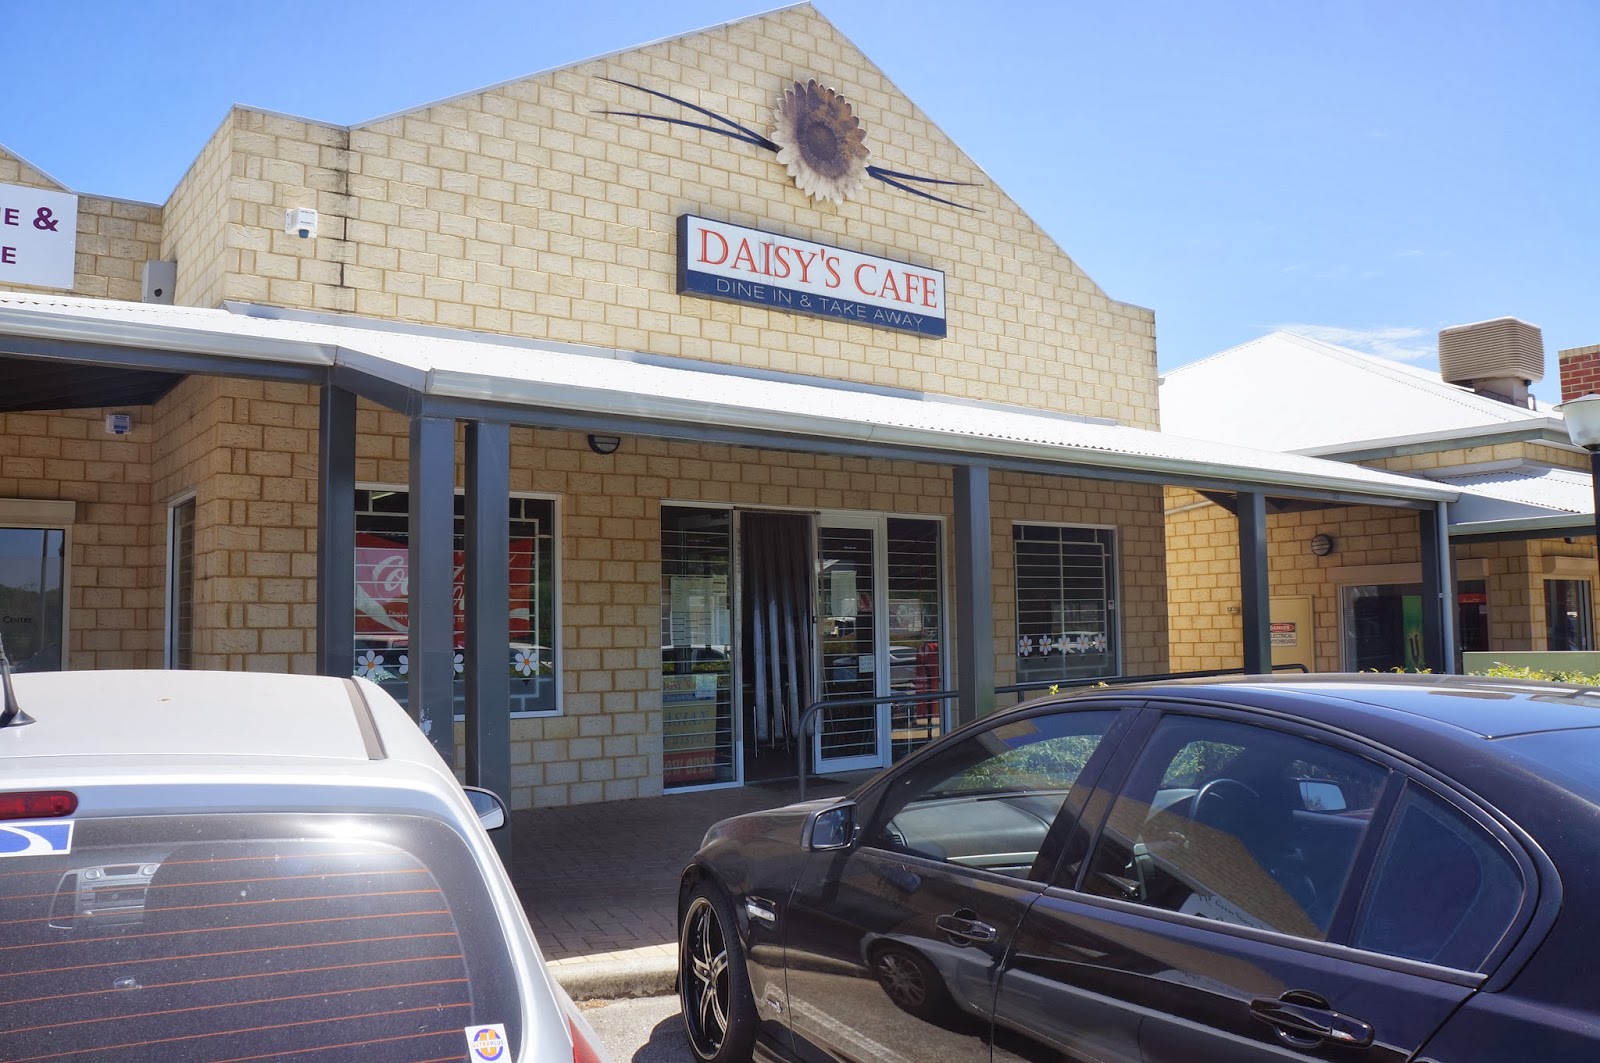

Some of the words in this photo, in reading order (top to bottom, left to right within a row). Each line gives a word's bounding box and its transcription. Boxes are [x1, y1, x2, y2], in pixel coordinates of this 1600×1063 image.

[0, 207, 20, 226] E
[33, 207, 59, 232] &
[1, 246, 17, 264] E
[697, 228, 841, 289] DAISY'S
[853, 263, 937, 309] CAFE
[716, 278, 765, 300] DINE
[773, 288, 792, 305] IN
[800, 294, 812, 308] &
[819, 297, 867, 318] TAKE
[873, 308, 923, 331] AWAY
[663, 759, 684, 777] OW
